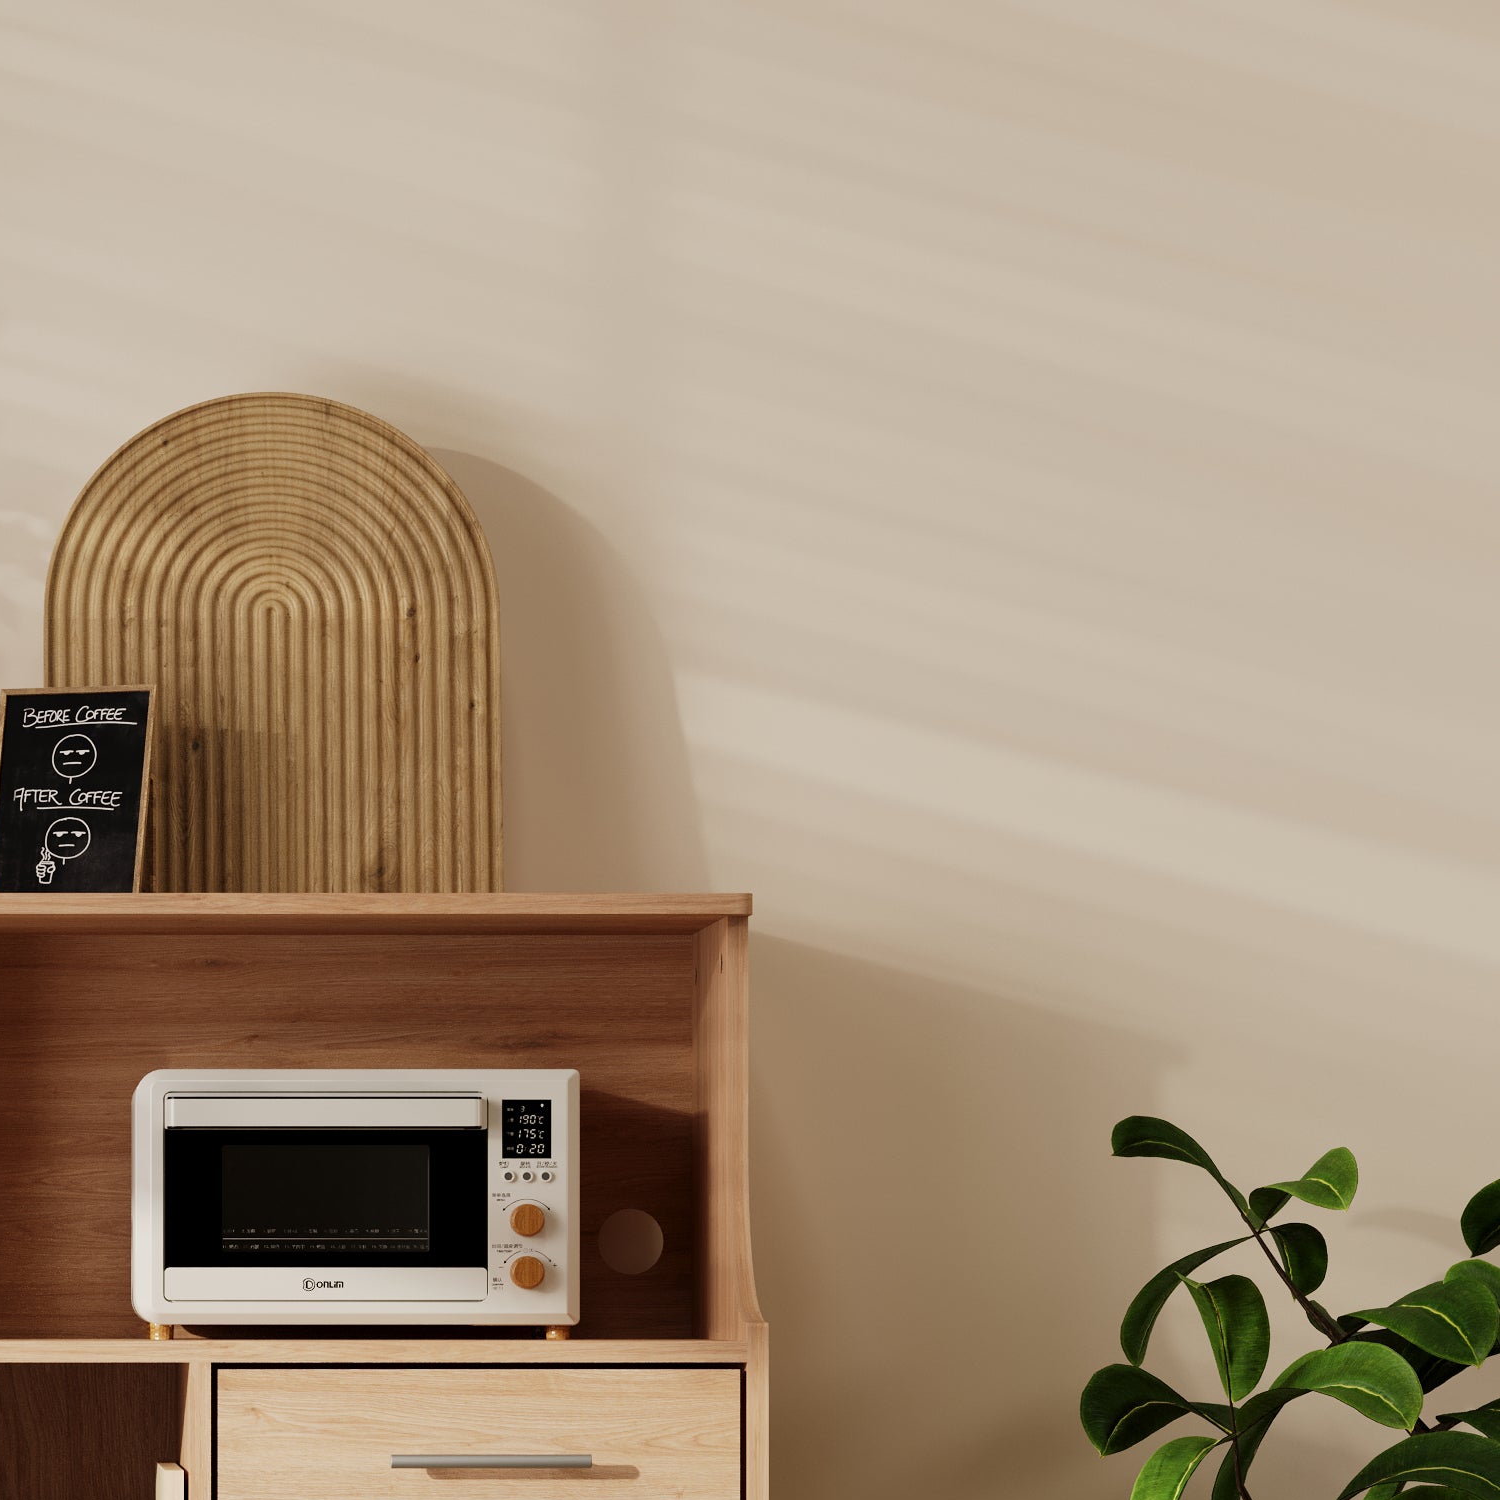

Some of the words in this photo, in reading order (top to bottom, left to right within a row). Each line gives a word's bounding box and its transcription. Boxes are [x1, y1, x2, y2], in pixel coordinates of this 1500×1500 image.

[22, 707, 71, 728] BEFORE
[75, 705, 127, 724] COFFEE
[13, 787, 62, 812] AFTER
[69, 788, 123, 807] COFFEE
